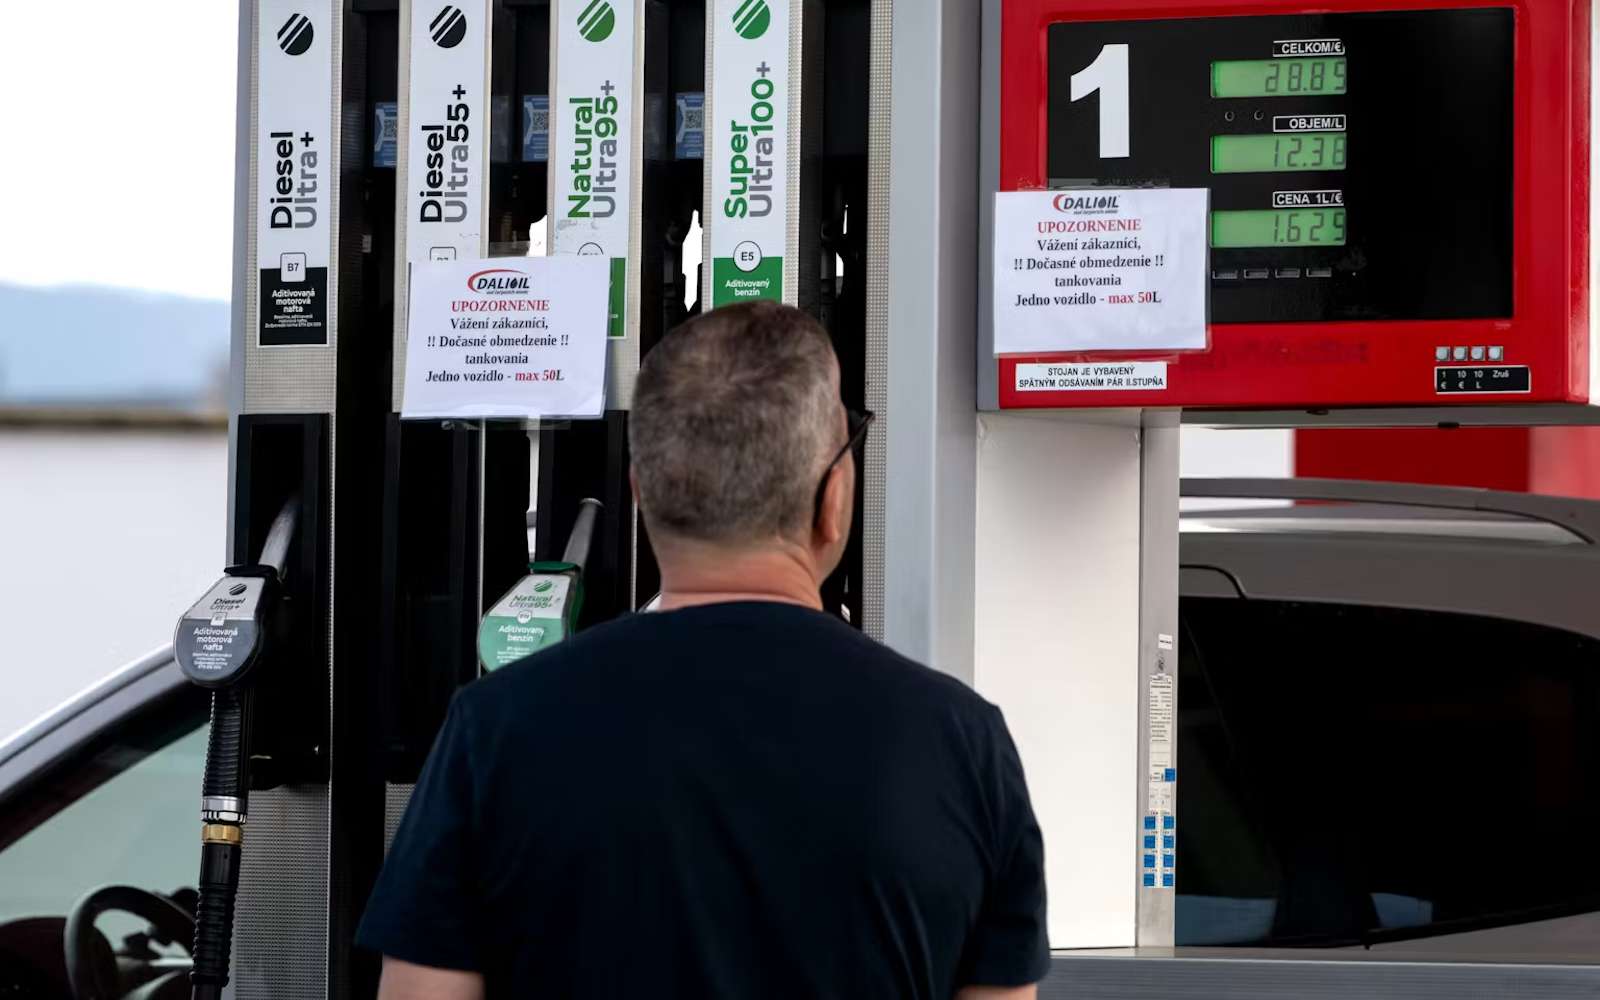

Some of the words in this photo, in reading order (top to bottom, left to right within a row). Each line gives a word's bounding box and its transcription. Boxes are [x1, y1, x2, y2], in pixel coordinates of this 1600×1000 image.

[1281, 42, 1341, 54] CELKOM/€
[1070, 43, 1130, 158] 1
[1289, 117, 1342, 129] OBJEM/L
[749, 61, 774, 217] Ultra100+
[444, 84, 469, 222] Ultra55+
[592, 80, 618, 218] Ultra95+
[1274, 137, 1346, 167] 12.38
[567, 97, 593, 218] Natural
[420, 125, 444, 222] Diesel
[724, 120, 754, 219] Super
[270, 132, 293, 228] Diesel
[294, 131, 318, 228] Ultra+
[1277, 194, 1310, 205] CENA
[1316, 193, 1343, 204] 1L/€
[1037, 218, 1142, 233] UPOZORNENIE
[1037, 239, 1078, 251] Vážení
[1081, 237, 1141, 250] zákazníci,
[741, 251, 754, 261] E5
[1013, 258, 1023, 270] !!
[1026, 256, 1076, 270] Dočasné
[1079, 255, 1151, 269] obmedzenie
[1155, 254, 1164, 266] !!
[287, 263, 299, 272] B7
[1055, 274, 1121, 287] tankovania
[451, 299, 550, 313] UPOZORNENIE
[1015, 294, 1050, 307] Jedno
[1053, 293, 1096, 305] vozidlo
[1108, 294, 1134, 304] max
[1137, 292, 1161, 304] 50L
[283, 304, 303, 313] nafta
[450, 317, 489, 330] Vážení
[492, 316, 549, 330] zákazníci,
[427, 336, 436, 347] !!
[439, 335, 487, 347] Dočasné
[490, 334, 557, 347] obmedzenie
[560, 334, 569, 346] !!
[465, 352, 528, 365] tankovania
[425, 370, 460, 383] Jedno
[463, 370, 504, 382] vozidlo
[515, 371, 539, 381] max
[542, 369, 564, 381] 50L
[1047, 367, 1079, 376] STOJAN
[1081, 367, 1091, 375] JE
[1094, 364, 1135, 375] VYBAVENÝ
[1058, 376, 1104, 387] ODSÁVANÍM
[1107, 376, 1123, 386] PÁR
